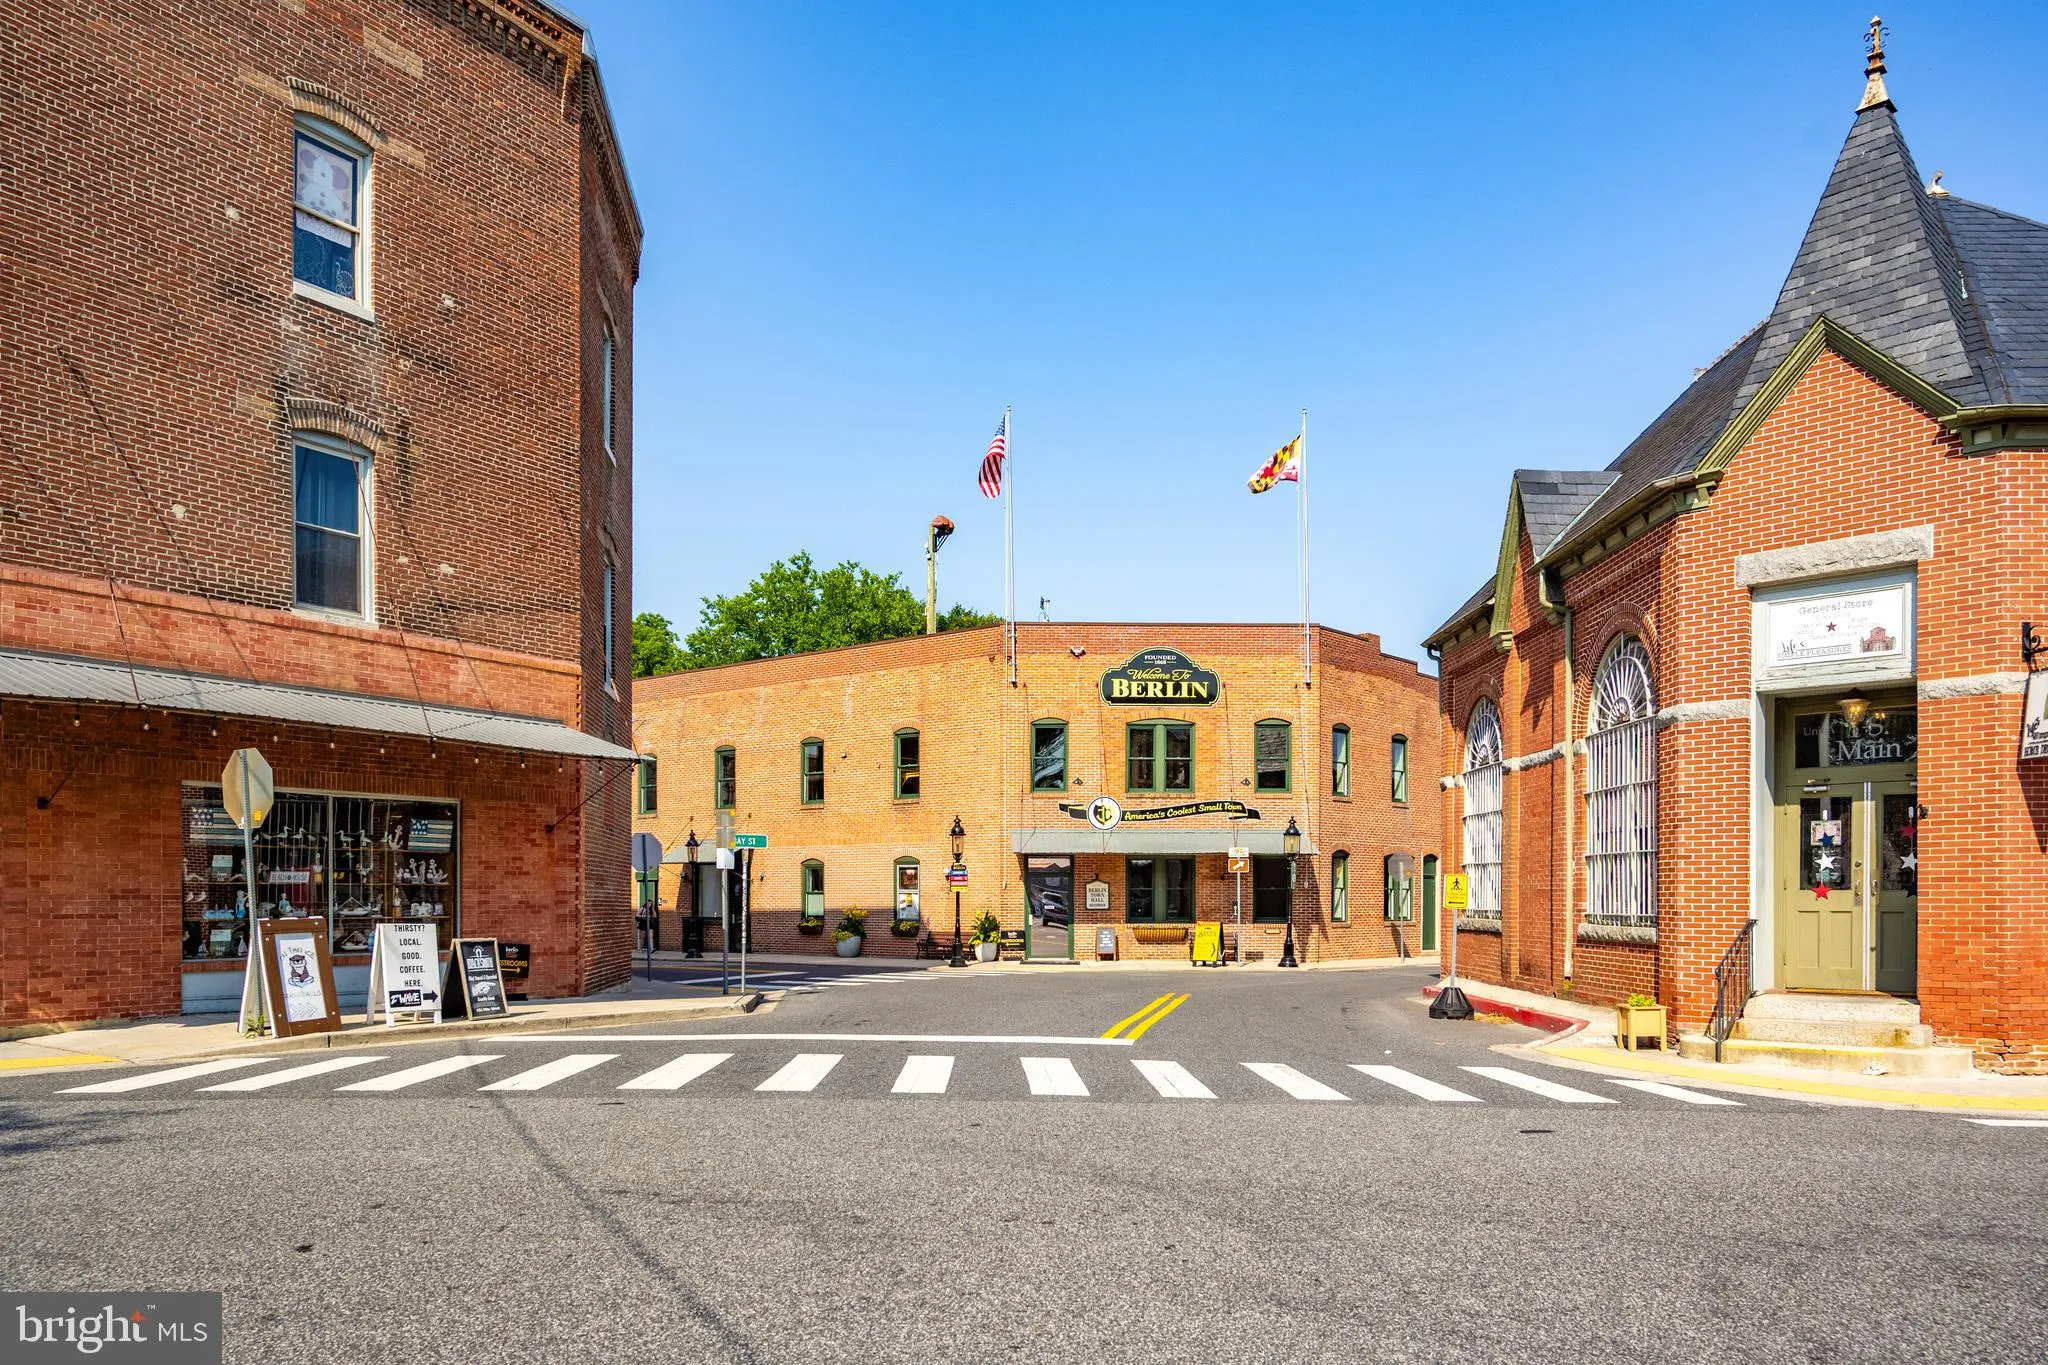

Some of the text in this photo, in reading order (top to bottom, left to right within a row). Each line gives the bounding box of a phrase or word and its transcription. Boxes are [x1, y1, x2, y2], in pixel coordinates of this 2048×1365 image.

[1799, 599, 1874, 615] General Store
[1127, 667, 1193, 681] Welcome To
[1111, 678, 1209, 698] BERLIN
[1836, 740, 1903, 761] Main
[1124, 802, 1243, 821] America's Coolest Small Town
[736, 837, 756, 845] AY ST
[394, 924, 425, 932] THIRSTY?
[399, 938, 422, 946] LOCAL.
[401, 952, 422, 960] GOOD.
[500, 959, 528, 967] STROOMS
[399, 965, 426, 974] COFFEE.
